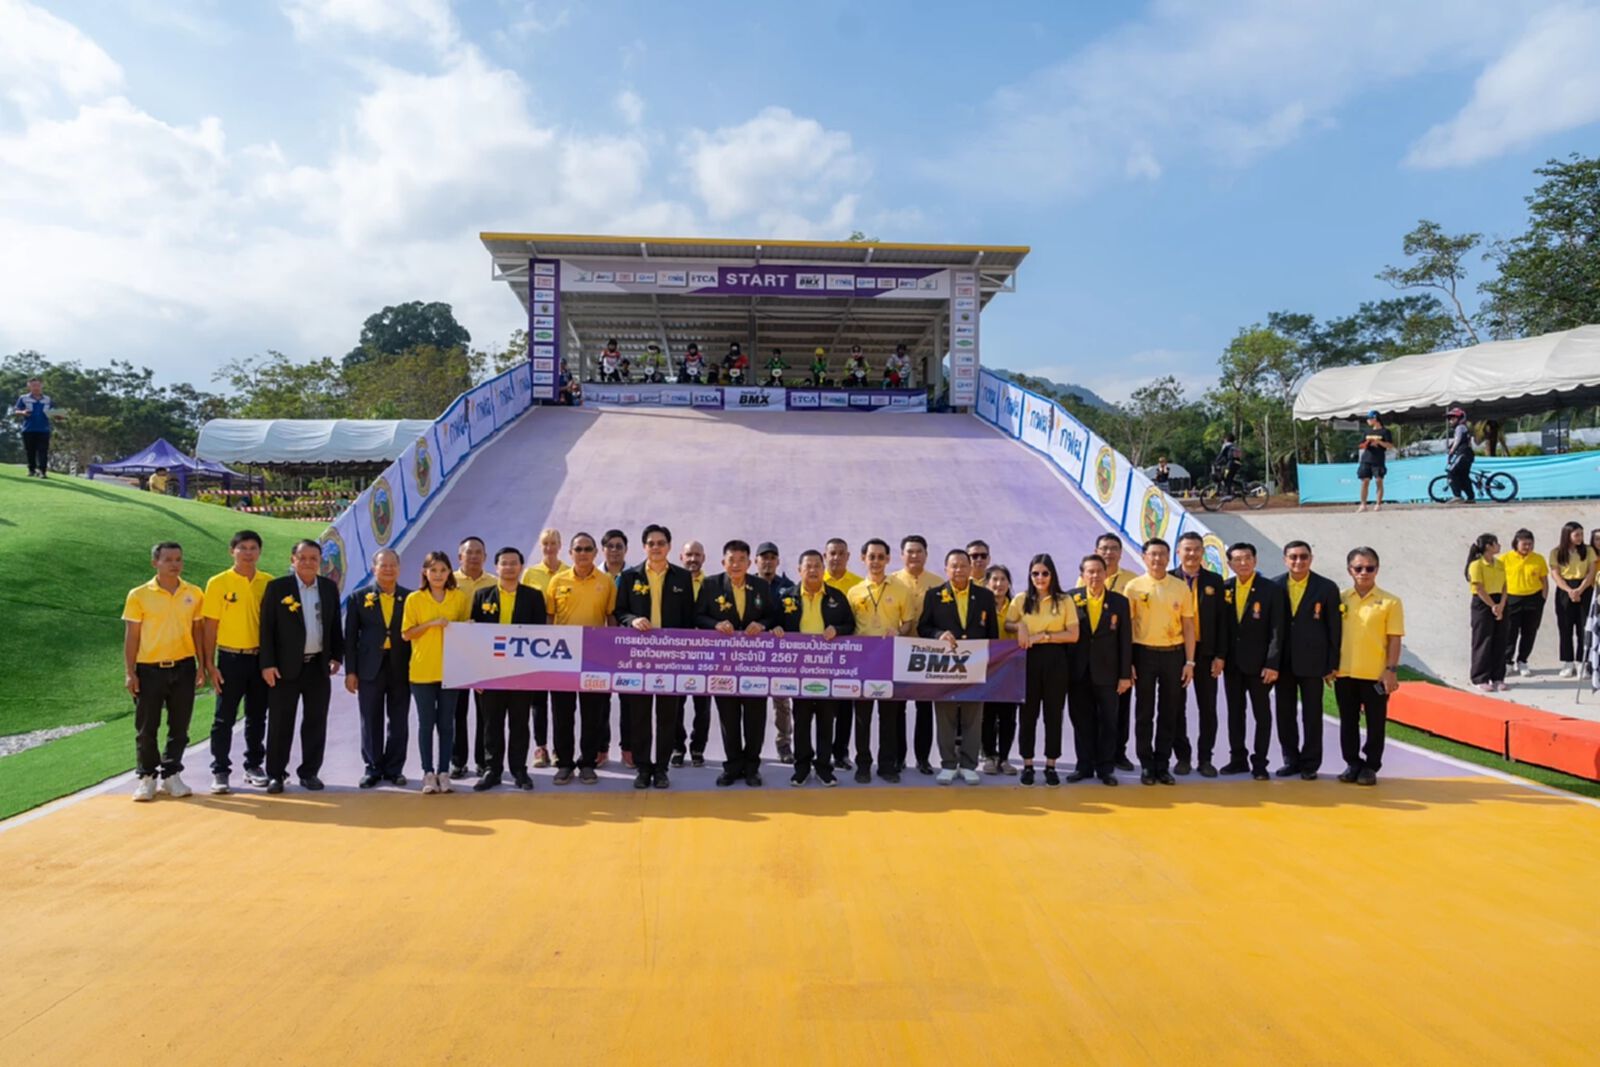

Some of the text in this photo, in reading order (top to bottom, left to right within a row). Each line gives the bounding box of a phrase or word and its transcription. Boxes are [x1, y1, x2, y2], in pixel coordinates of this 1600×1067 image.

[697, 275, 716, 283] TCA
[725, 273, 790, 287] START
[738, 394, 770, 405] BMX
[508, 636, 573, 660] TCA
[911, 644, 946, 654] Thailand
[730, 650, 766, 662] ประจำปี
[770, 652, 799, 663] 2567
[839, 655, 847, 664] 5
[907, 653, 971, 673] BMX
